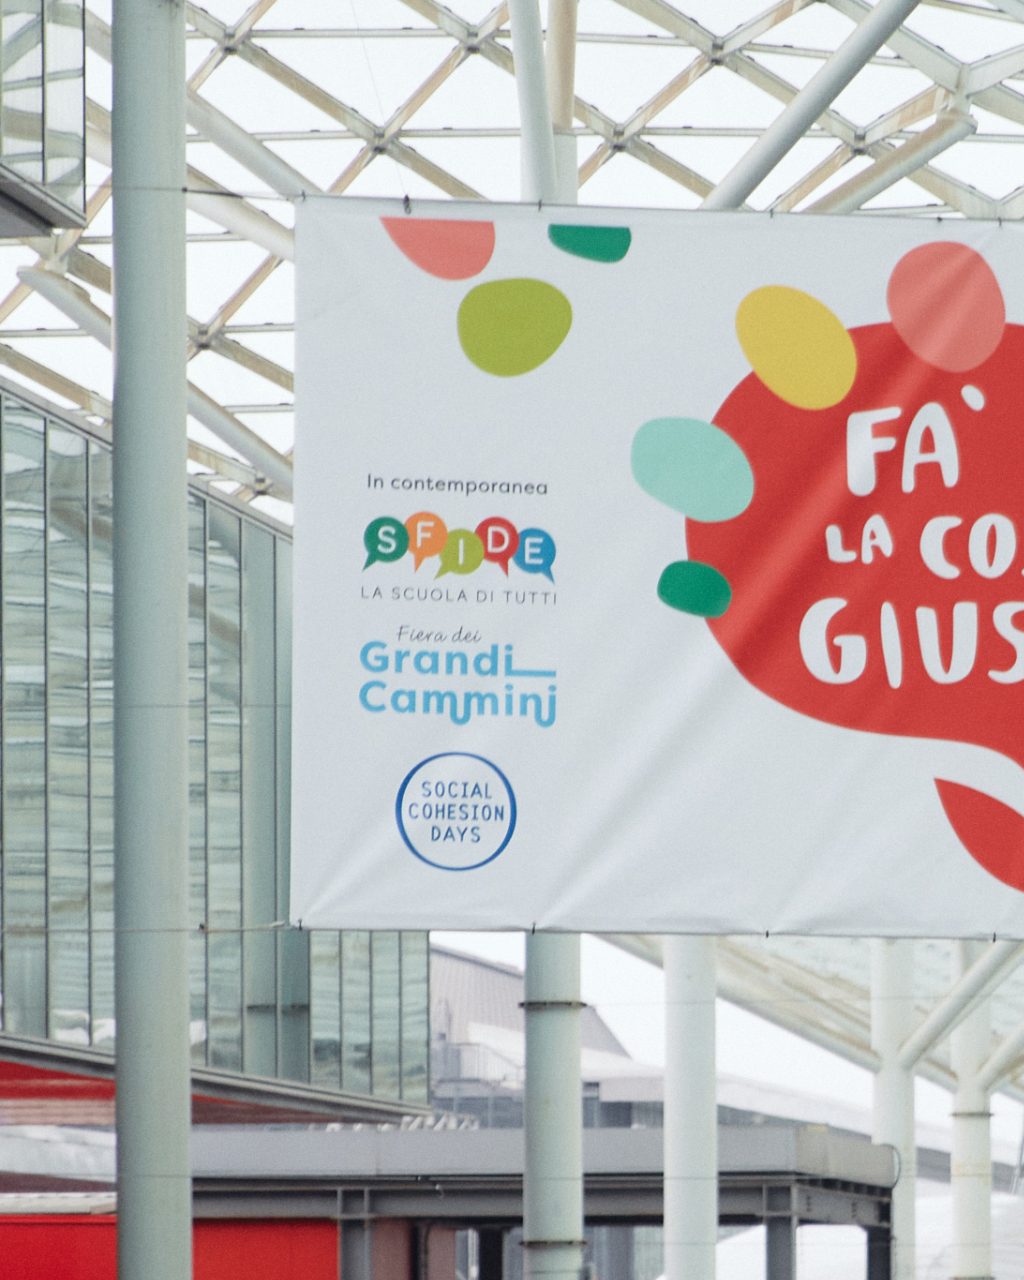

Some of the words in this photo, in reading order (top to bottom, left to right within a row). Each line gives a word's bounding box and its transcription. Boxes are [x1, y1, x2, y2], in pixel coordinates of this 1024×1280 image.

[367, 473, 384, 489] In
[391, 476, 548, 497] contemporanea
[376, 521, 544, 566] SFIDE
[825, 513, 894, 565] LA
[360, 586, 383, 600] LA
[391, 586, 469, 602] SCUOLA
[476, 590, 494, 603] DI
[503, 591, 557, 605] TUTTI
[397, 625, 448, 643] Fiera
[451, 625, 482, 643] dei
[360, 640, 557, 677] Grandi
[359, 680, 557, 728] Cammini
[421, 781, 493, 800] SOCIAL
[408, 802, 506, 821] COHESION
[430, 826, 482, 843] DAYS
